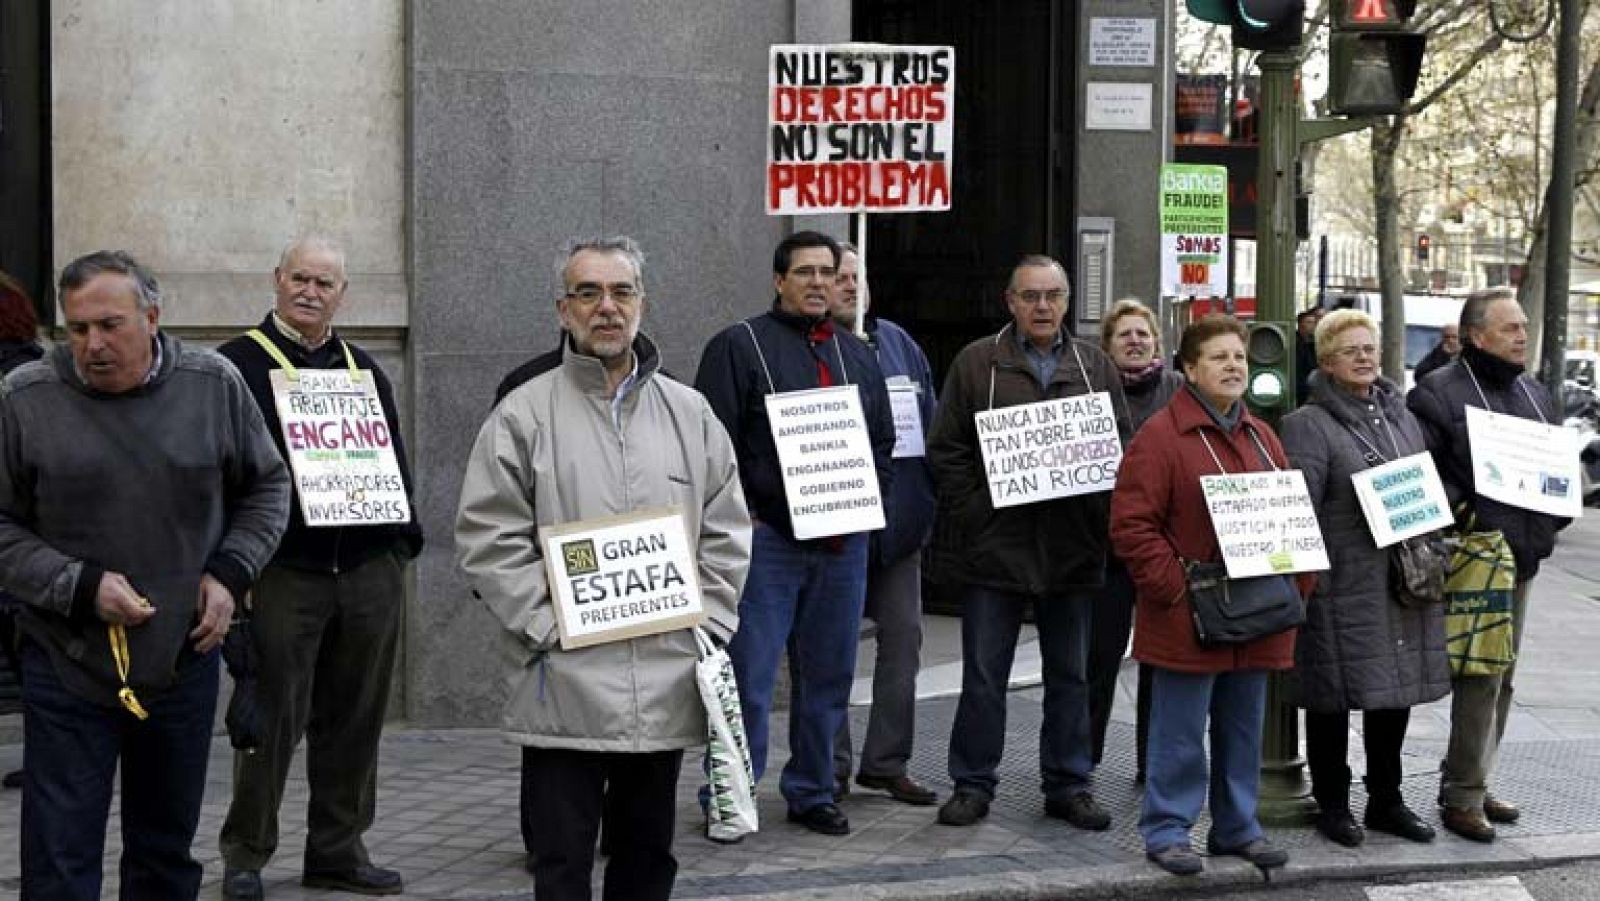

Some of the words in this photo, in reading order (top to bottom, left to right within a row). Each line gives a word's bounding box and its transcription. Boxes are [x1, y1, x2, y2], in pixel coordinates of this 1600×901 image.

[775, 52, 949, 86] NUESTROS
[775, 85, 946, 122] DERECHOS
[773, 123, 817, 161] NO
[828, 123, 893, 161] SON
[904, 123, 945, 161] EL
[769, 162, 949, 210] PROBLEMA
[1163, 171, 1223, 192] Bankia
[1177, 235, 1221, 254] SOMOS
[1182, 264, 1206, 284] NO
[290, 395, 380, 417] ARBITRAJE
[780, 400, 849, 418] NOSOTROS
[979, 409, 1031, 434] NUNCA
[1035, 404, 1057, 424] UN
[800, 438, 849, 454] BANKIA
[983, 433, 1020, 455] TAN
[1024, 423, 1075, 447] POBRE
[1079, 416, 1113, 436] HIZO
[989, 461, 998, 477] A
[1001, 451, 1040, 474] UNOS
[1040, 437, 1118, 468] CHORIZOS
[799, 477, 866, 497] GOBIERNO
[992, 473, 1038, 499] TAN
[1050, 461, 1117, 490] RICOS
[308, 500, 405, 521] INVERSORES
[793, 496, 878, 516] ENCUBRIENDO
[602, 532, 667, 560] GRAN
[571, 560, 686, 605] ESTAFA
[580, 592, 690, 625] PREFERENTES
